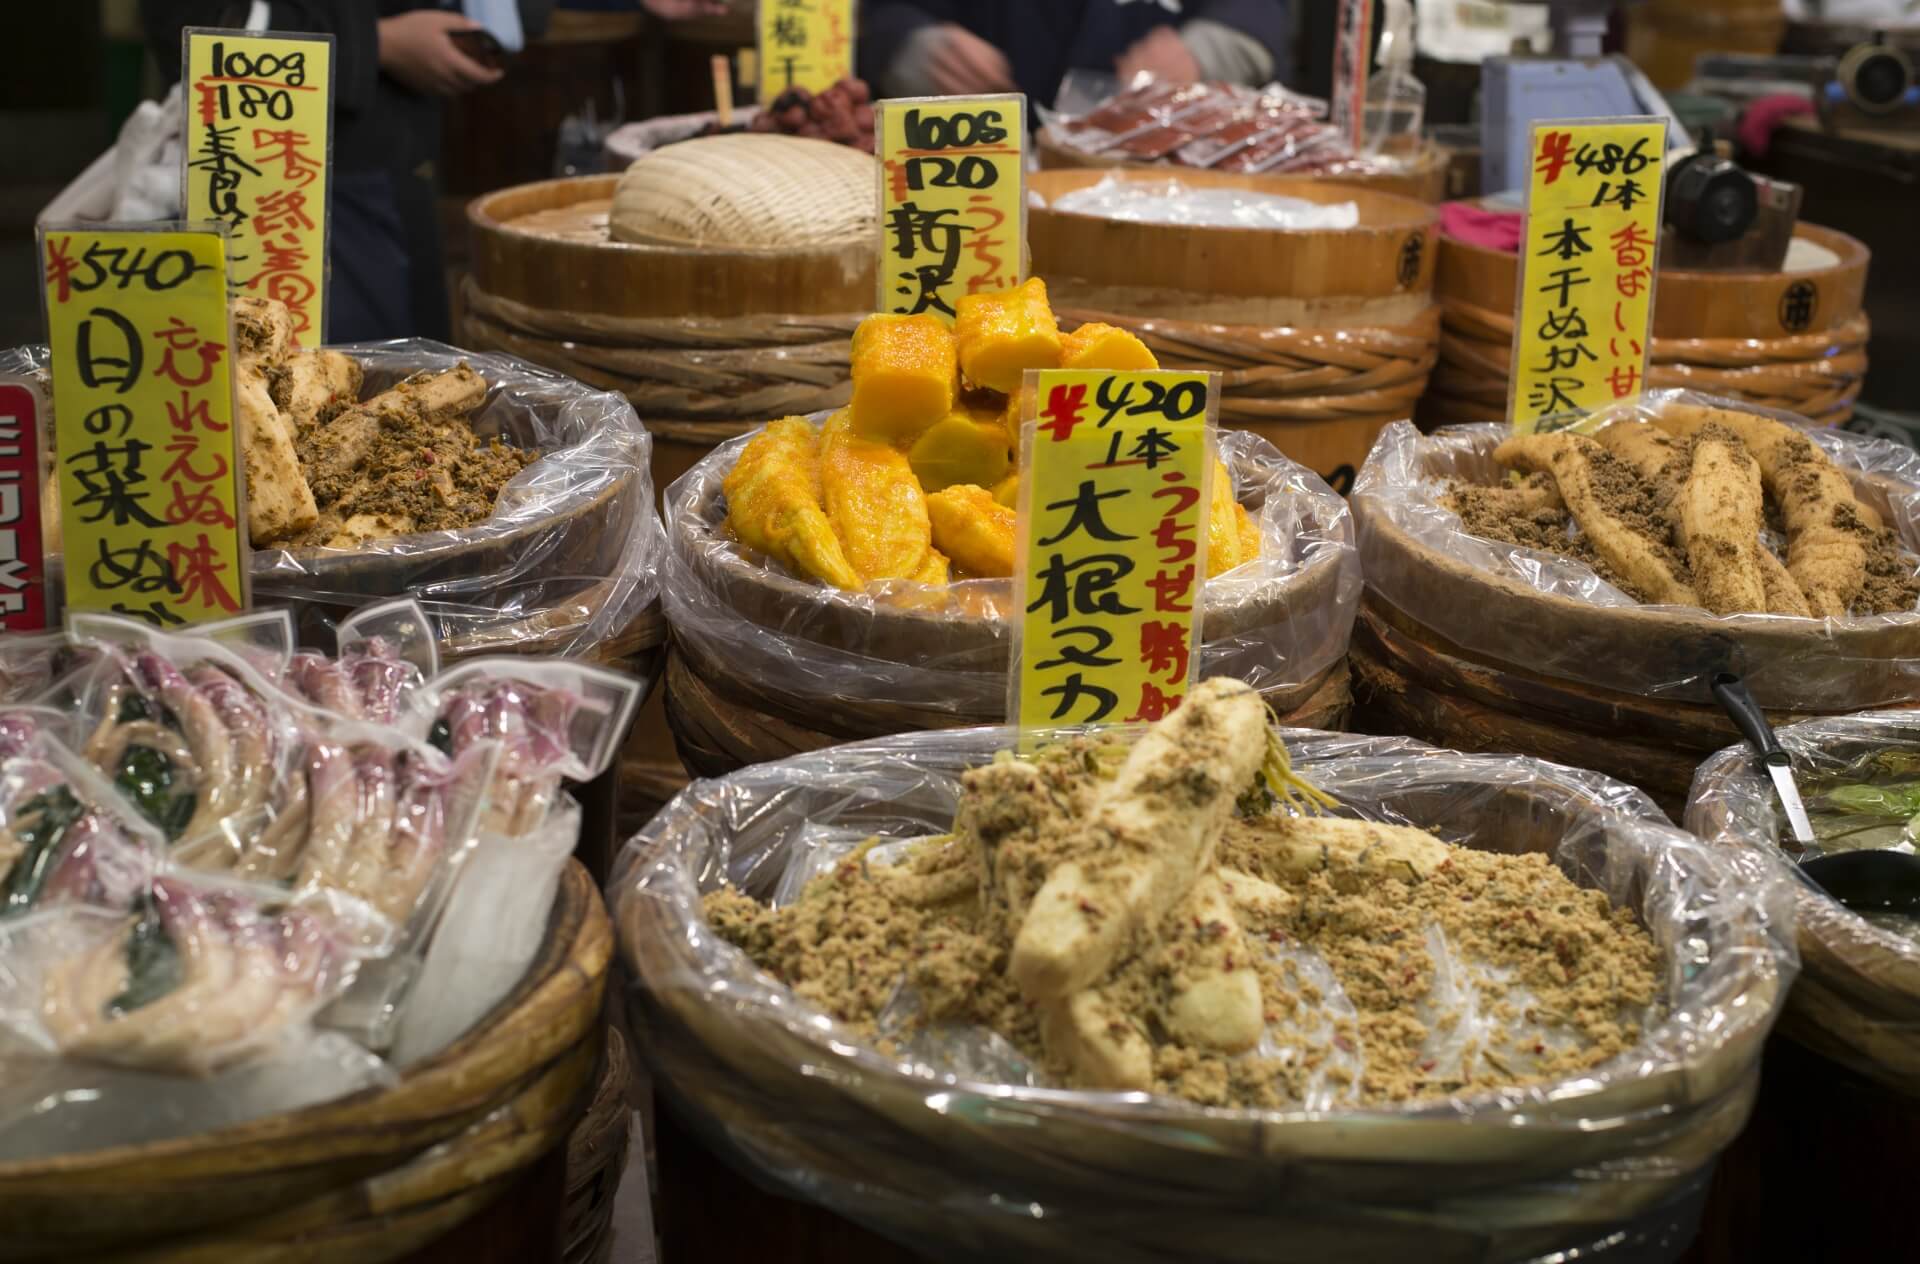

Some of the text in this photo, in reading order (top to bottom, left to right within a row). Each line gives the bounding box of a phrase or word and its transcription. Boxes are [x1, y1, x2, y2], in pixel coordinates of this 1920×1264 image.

[212, 42, 305, 87] 100g
[884, 156, 998, 203] ¥120
[1590, 178, 1647, 211] 1本
[1037, 375, 1208, 442] ¥420
[1104, 427, 1181, 470] 1本
